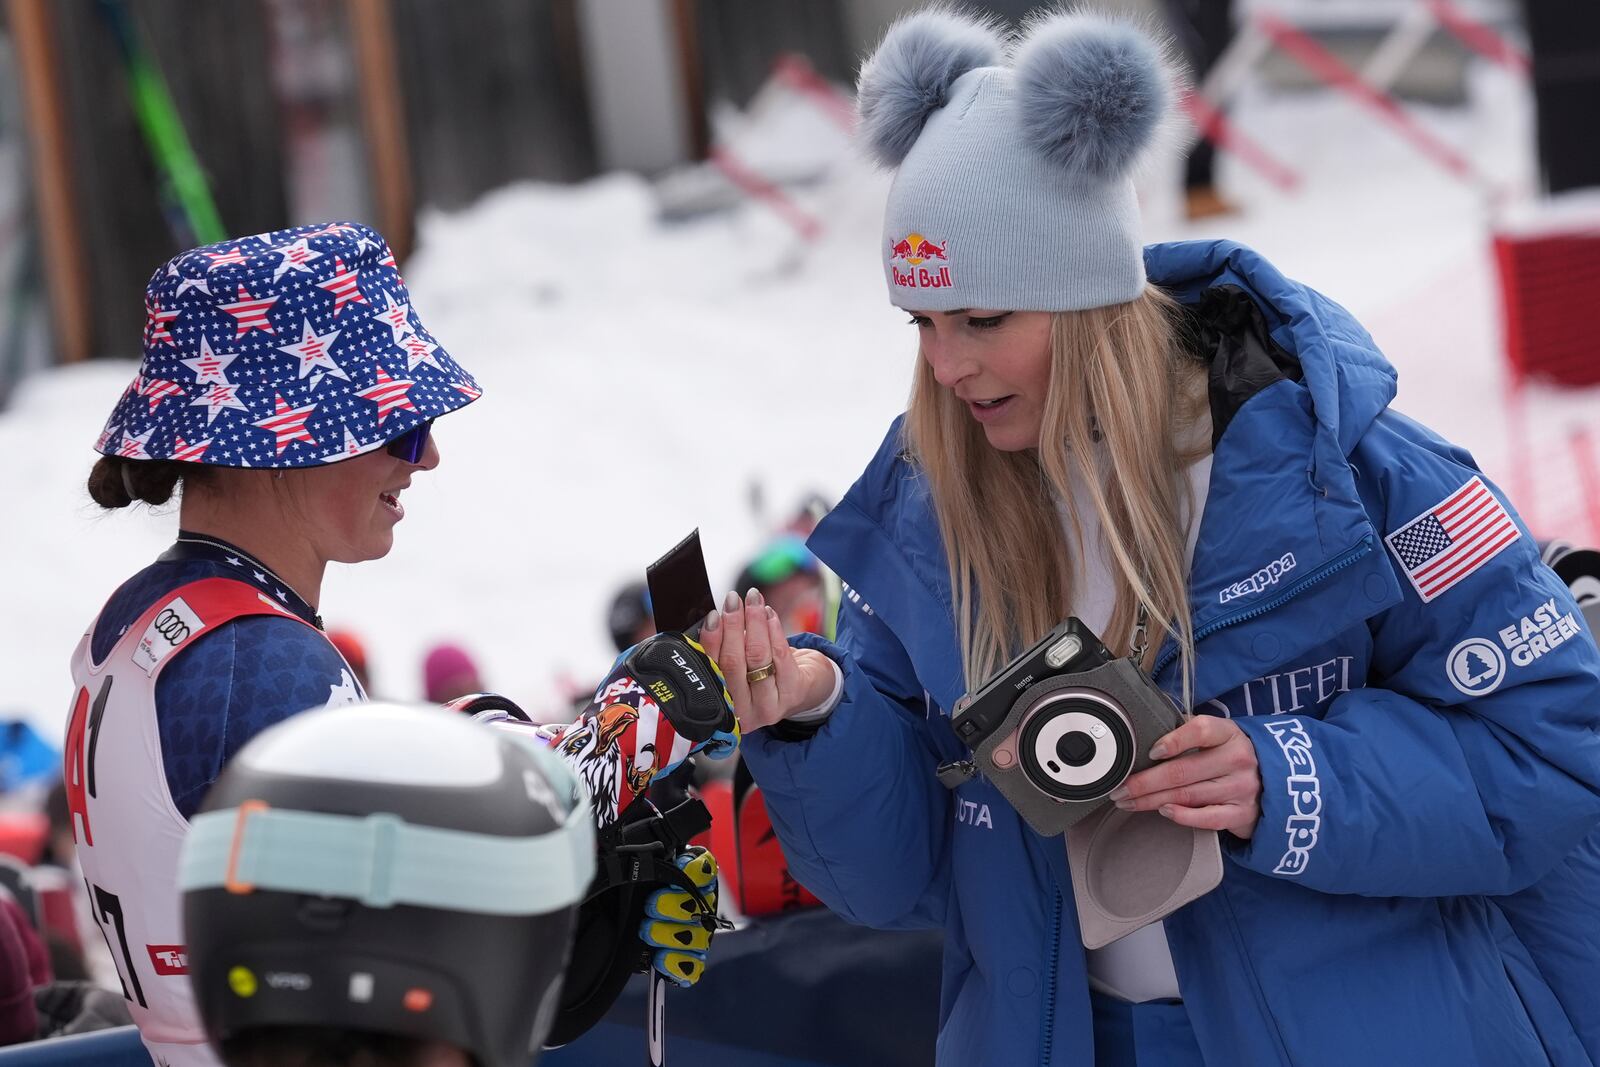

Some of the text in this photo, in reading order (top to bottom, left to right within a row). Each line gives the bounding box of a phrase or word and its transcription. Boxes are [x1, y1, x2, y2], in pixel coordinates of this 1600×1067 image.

[892, 266, 953, 289] Red Bull
[1219, 552, 1297, 604] Kappa
[1498, 597, 1561, 650] EASY
[1511, 611, 1581, 667] GREEN
[593, 677, 646, 704] USA
[648, 683, 672, 703] #FLY
[655, 680, 676, 699] HIGH
[671, 649, 706, 691] LEVEL
[64, 675, 113, 847] A1
[1264, 718, 1322, 875] Kappa
